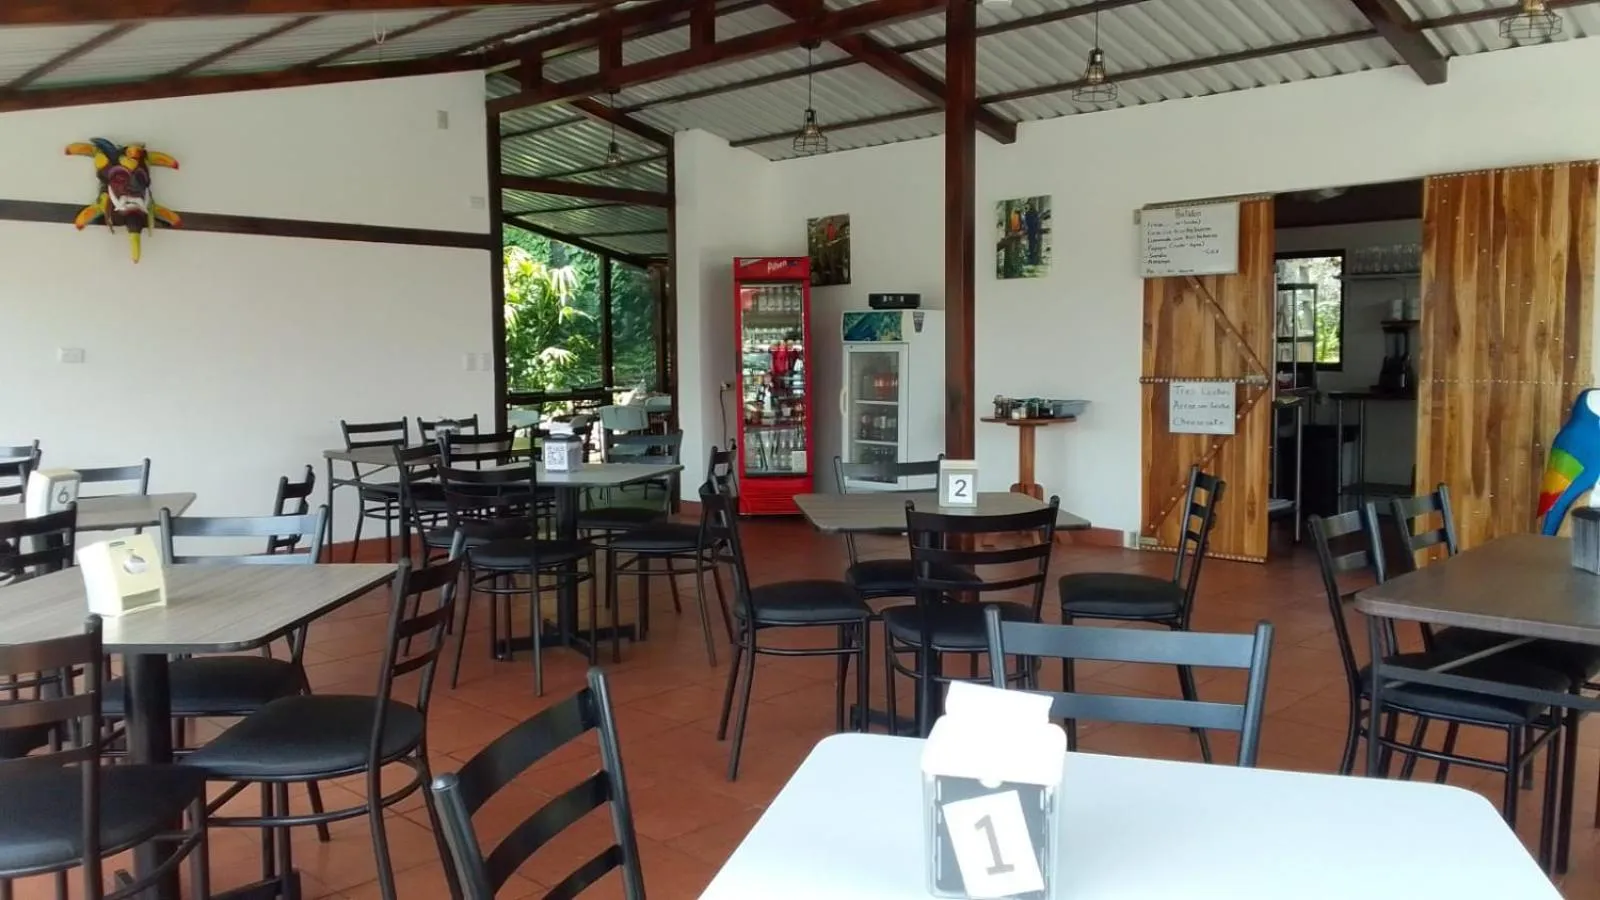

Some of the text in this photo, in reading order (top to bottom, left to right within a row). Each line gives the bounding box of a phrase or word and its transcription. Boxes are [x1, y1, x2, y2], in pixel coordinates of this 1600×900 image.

[57, 486, 69, 505] 6
[955, 479, 967, 497] 2
[974, 814, 1015, 876] 1
